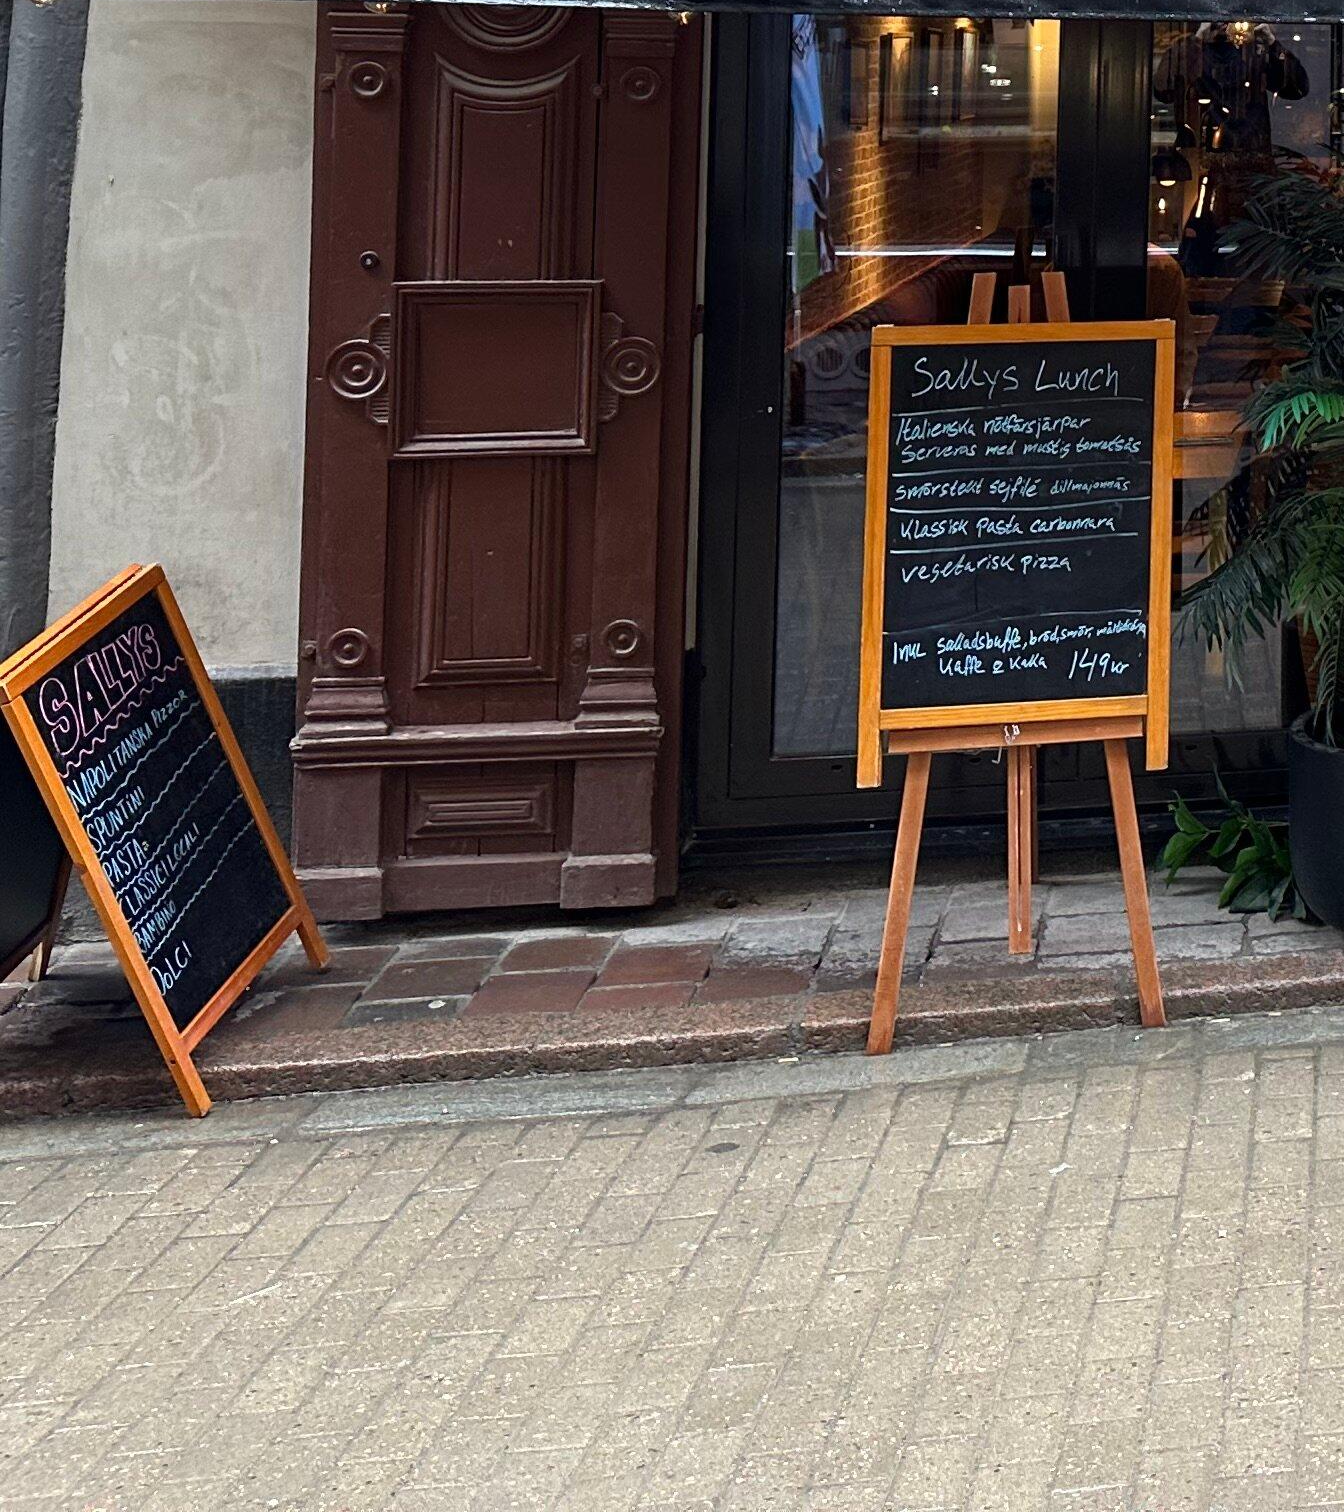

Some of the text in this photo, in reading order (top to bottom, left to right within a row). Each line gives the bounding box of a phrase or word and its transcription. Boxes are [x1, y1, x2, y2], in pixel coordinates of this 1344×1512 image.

[912, 356, 1119, 400] Sallys Lunch
[985, 440, 1014, 457] med
[1020, 553, 1072, 576] pizza
[39, 623, 162, 756] SALLYS
[66, 721, 154, 813] NAPOLITANSKA
